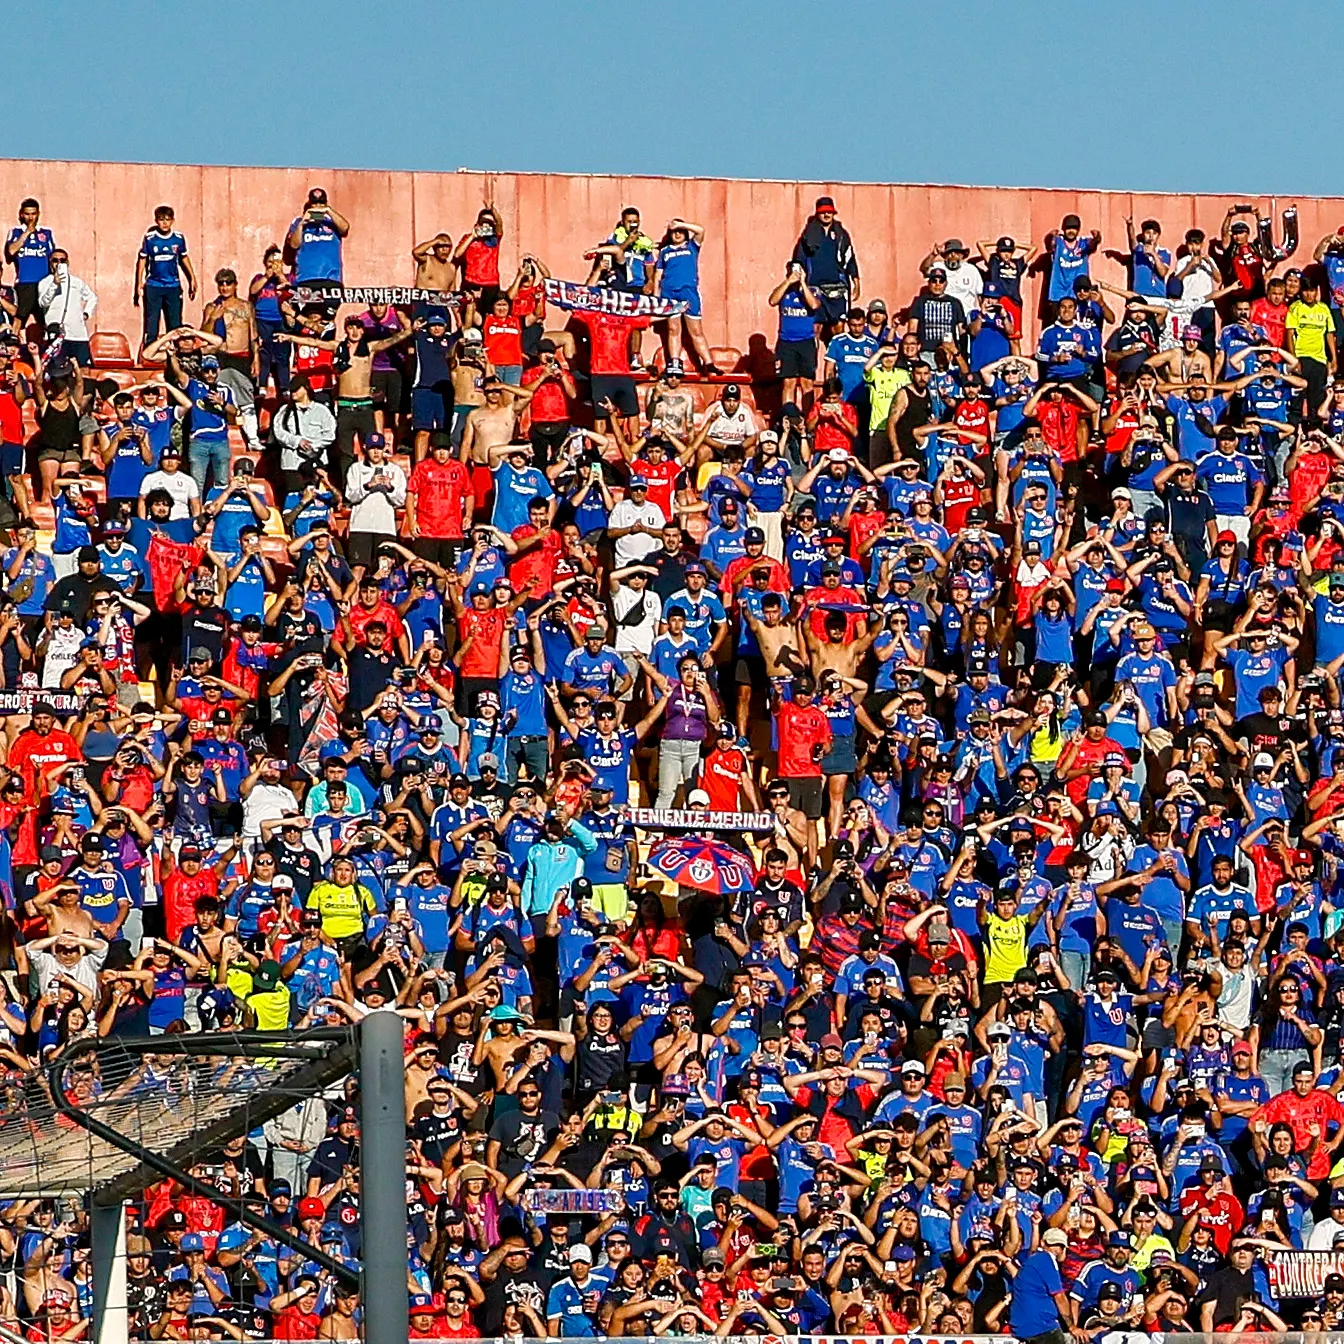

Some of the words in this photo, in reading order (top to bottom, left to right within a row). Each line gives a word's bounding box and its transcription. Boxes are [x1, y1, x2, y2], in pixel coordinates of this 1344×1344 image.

[322, 288, 341, 299] LO
[344, 289, 430, 301] BARNECHEA
[757, 476, 782, 485] Claro
[1214, 471, 1246, 482] Claro
[793, 548, 824, 560] Claro
[590, 755, 623, 767] Claro
[627, 808, 706, 825] TENIENTE
